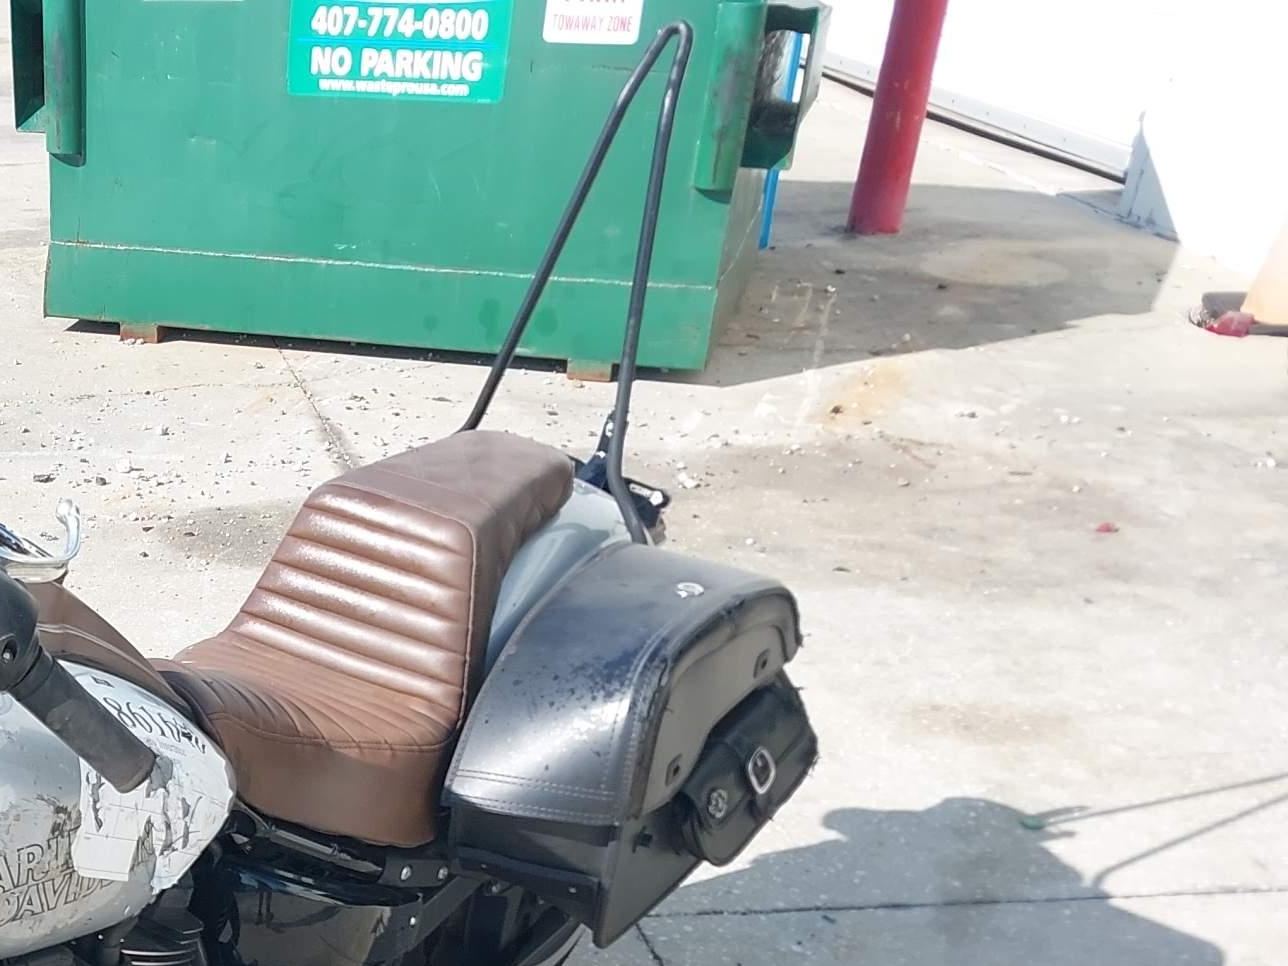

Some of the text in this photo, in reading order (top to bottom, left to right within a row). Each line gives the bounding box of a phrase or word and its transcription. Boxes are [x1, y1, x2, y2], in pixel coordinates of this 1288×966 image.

[311, 5, 489, 40] 407-774-0800
[553, 13, 634, 33] TOWAWAY ZONE
[311, 45, 485, 82] NO PARKING
